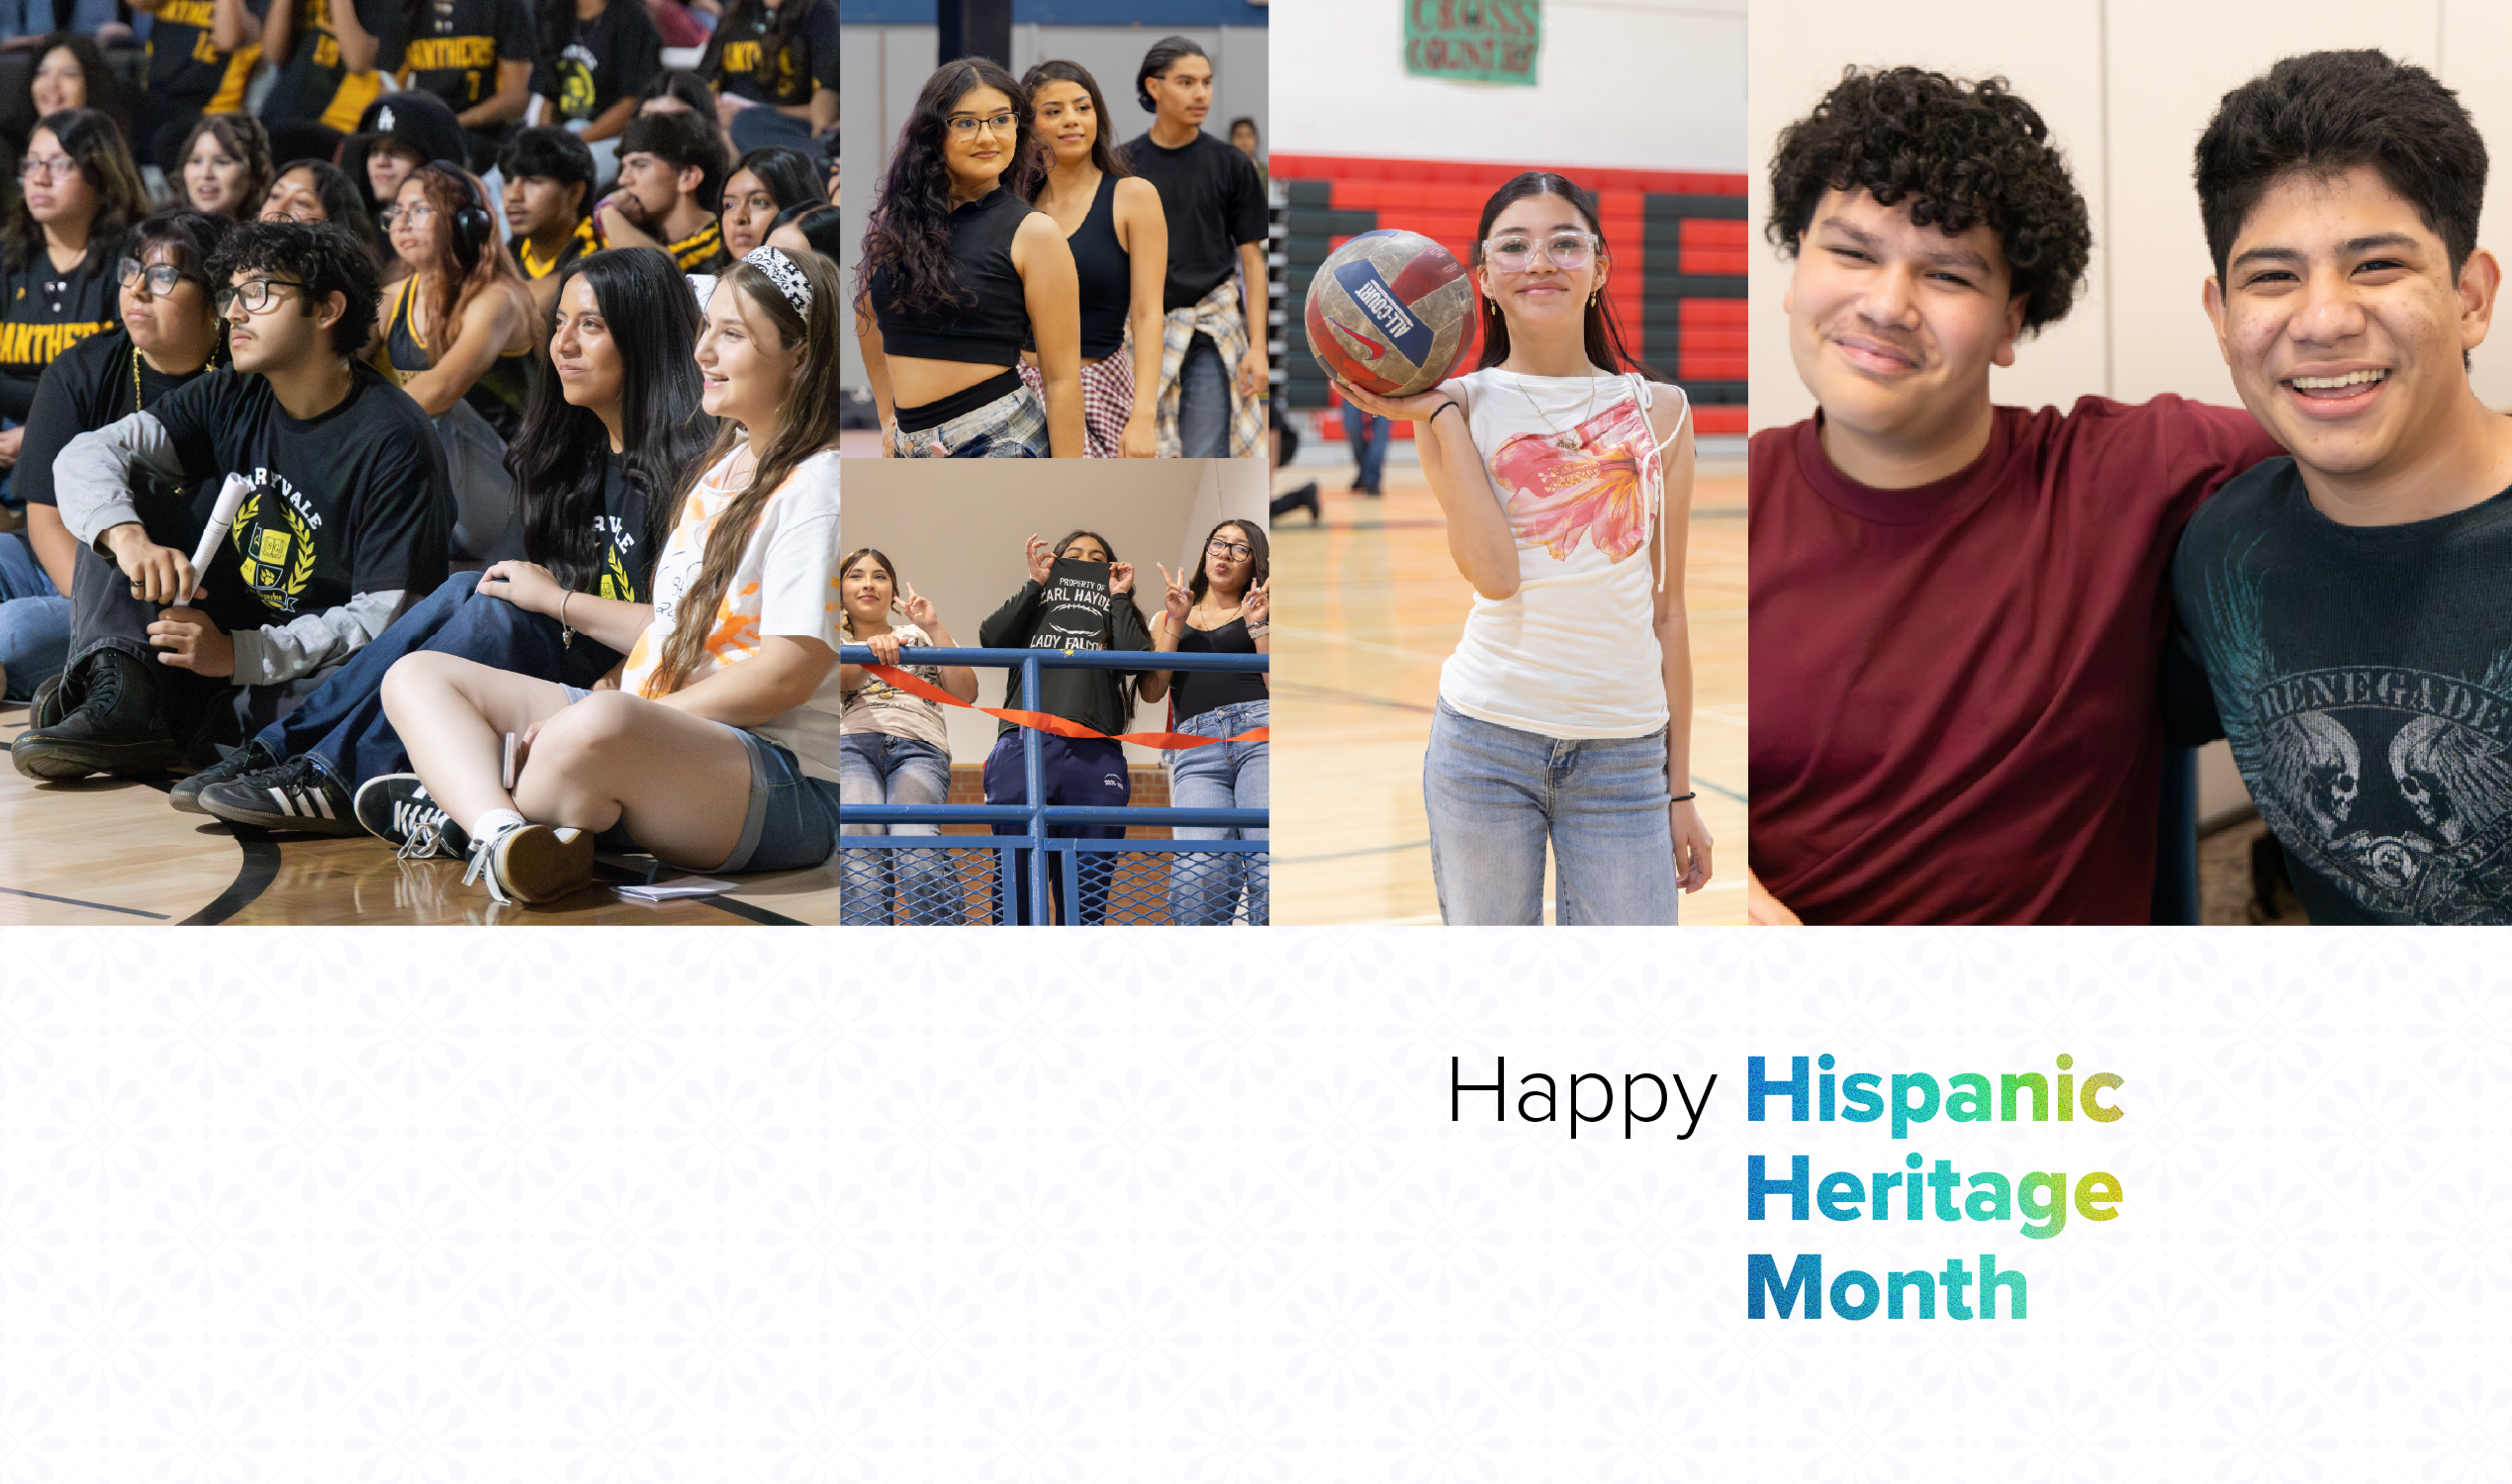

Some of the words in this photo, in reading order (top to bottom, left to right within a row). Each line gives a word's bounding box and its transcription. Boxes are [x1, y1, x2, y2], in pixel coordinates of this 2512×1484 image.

[1354, 281, 1412, 338] ALL-COURT
[0, 322, 114, 364] ANTHE
[1059, 577, 1095, 590] PROPERTY
[1096, 583, 1106, 592] OF
[1073, 589, 1111, 612] HAYDE
[1030, 634, 1062, 649] LADY
[2256, 671, 2509, 736] RENEGADE
